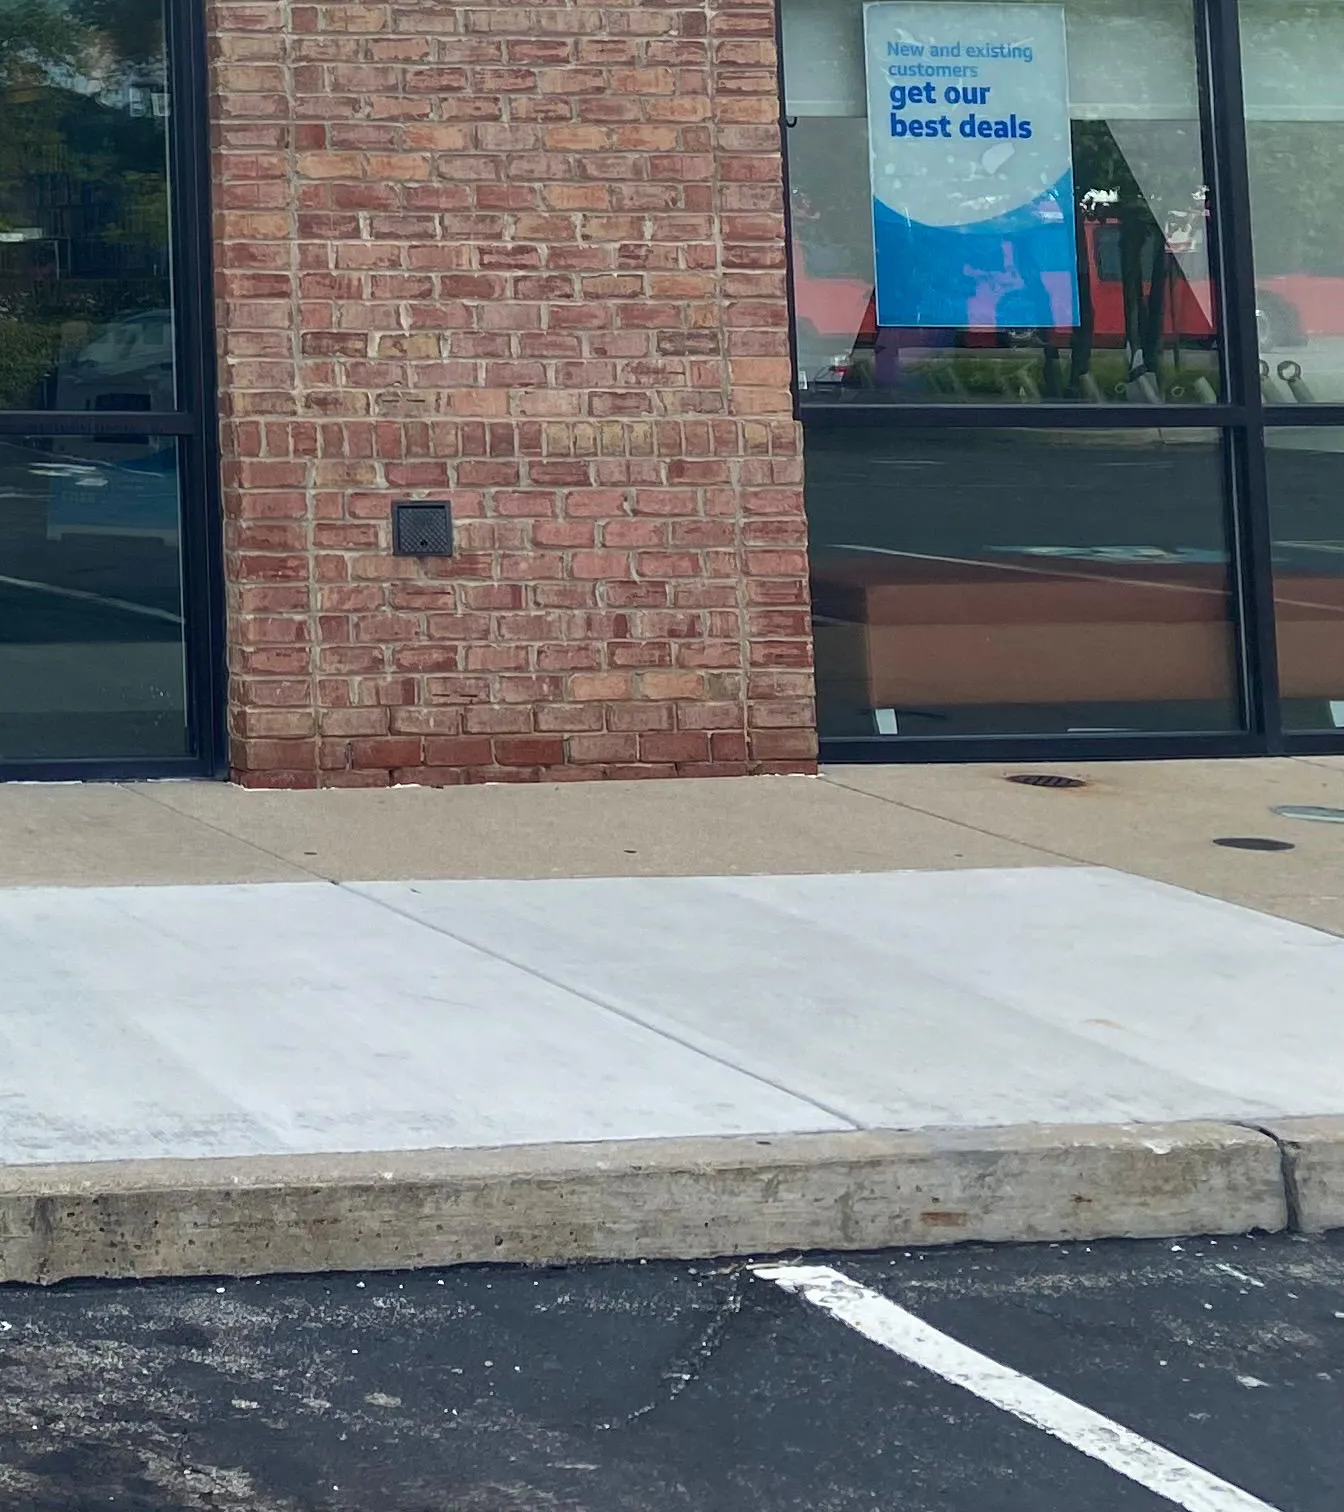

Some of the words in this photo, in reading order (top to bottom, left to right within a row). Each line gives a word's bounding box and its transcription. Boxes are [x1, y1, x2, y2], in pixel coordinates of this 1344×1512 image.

[887, 42, 923, 58] New
[929, 42, 961, 58] and
[965, 42, 1033, 63] existing
[888, 62, 978, 78] customers
[889, 82, 936, 110] get
[943, 86, 990, 105] our
[891, 113, 952, 138] best
[959, 114, 1033, 139] deals
